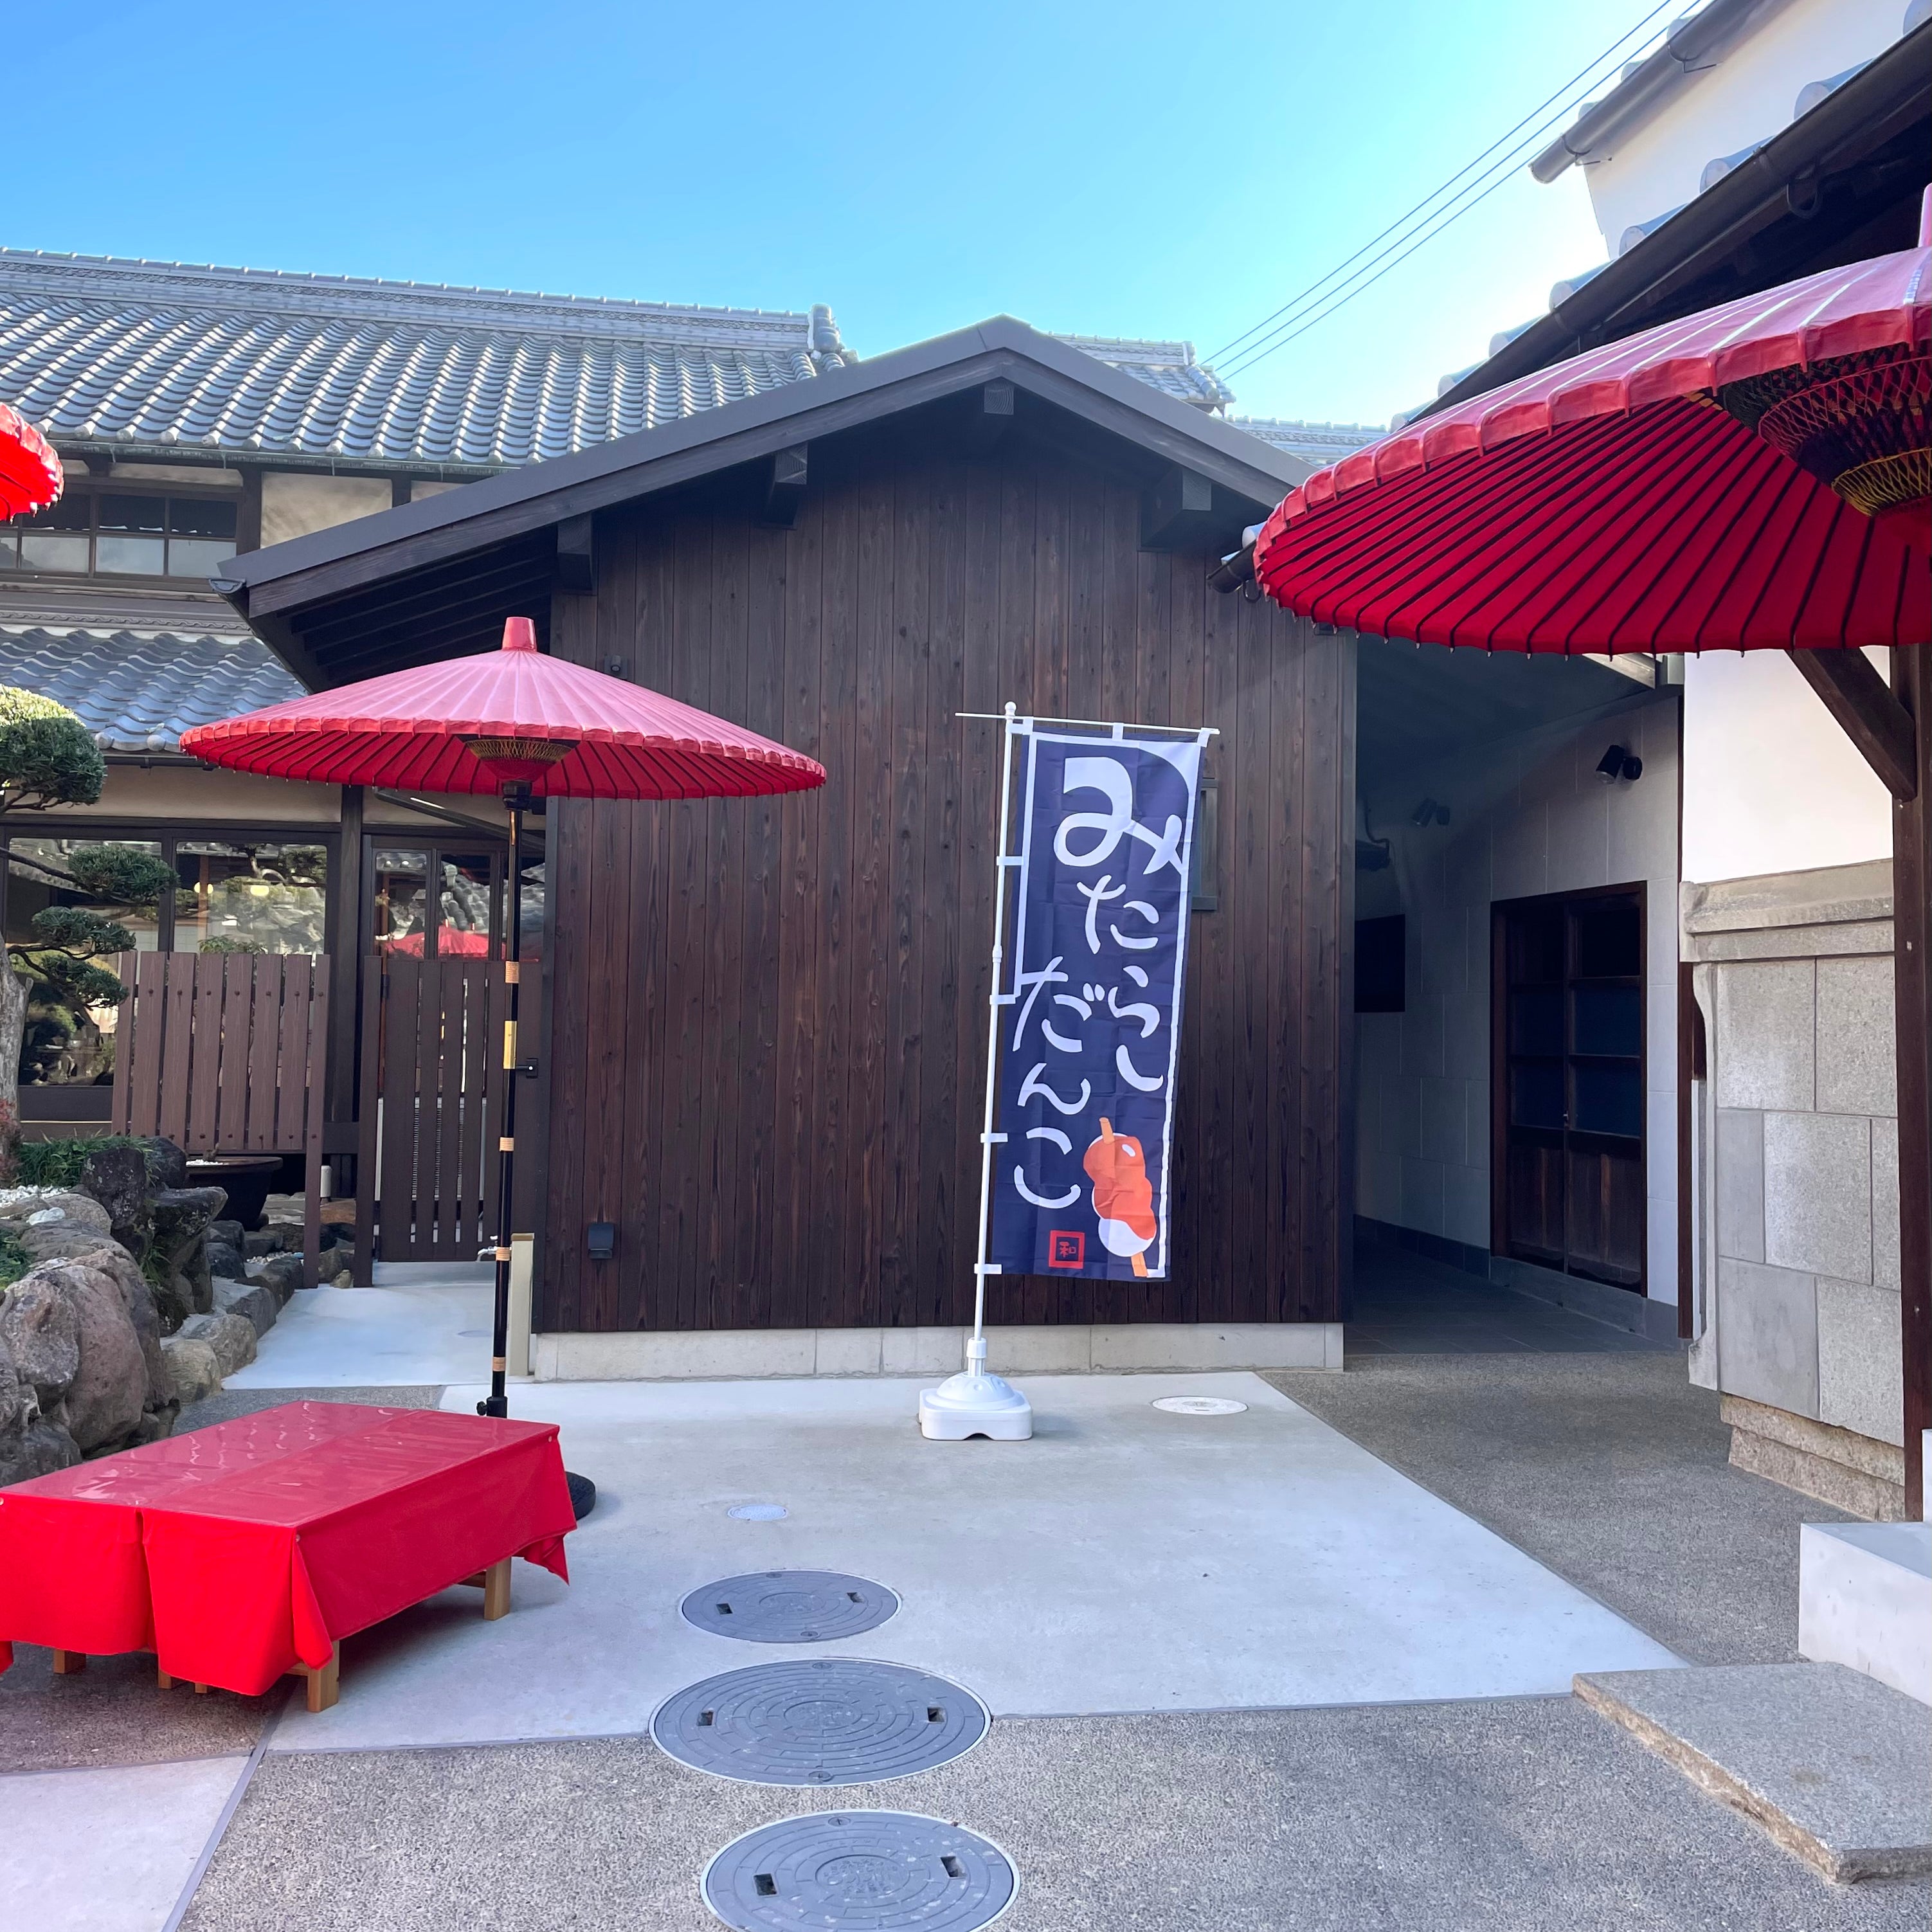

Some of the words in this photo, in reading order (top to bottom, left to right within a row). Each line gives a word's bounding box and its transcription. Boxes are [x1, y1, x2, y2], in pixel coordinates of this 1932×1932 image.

[1053, 757, 1183, 1092] みたらし
[1059, 1241, 1077, 1258] 和
